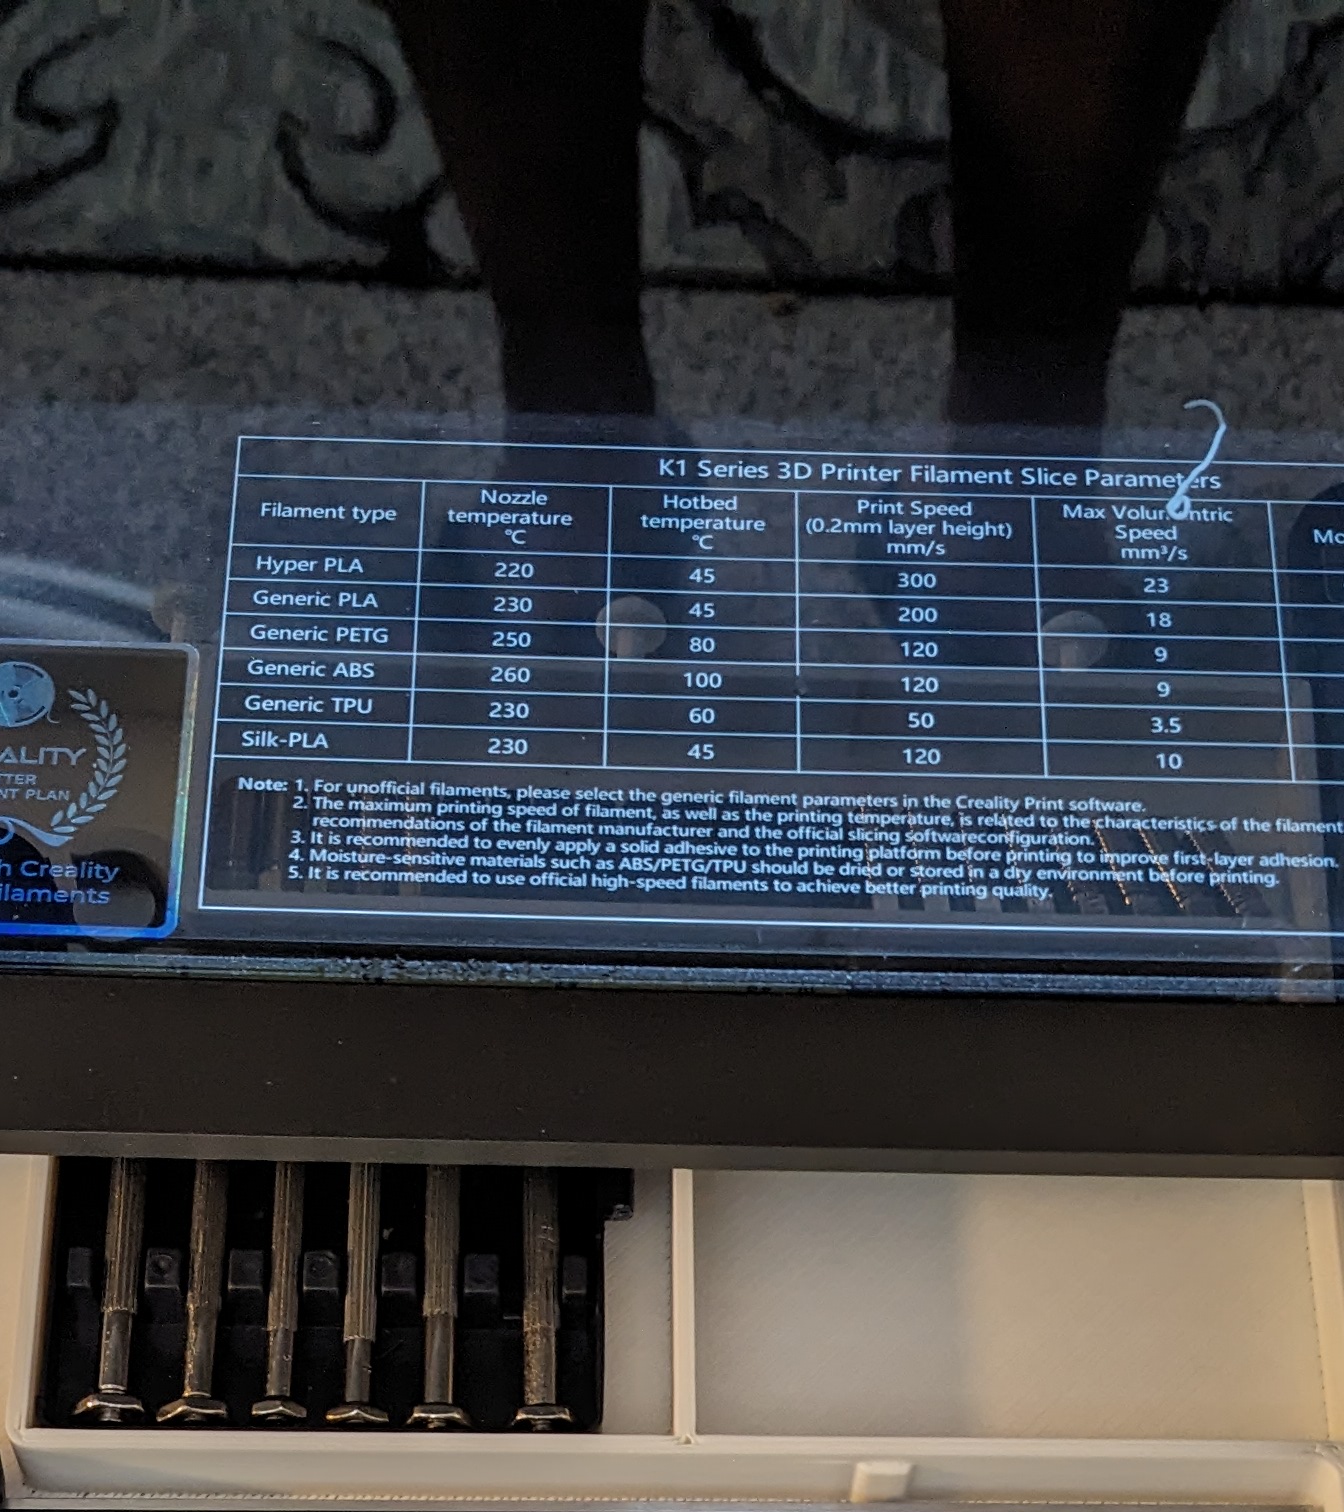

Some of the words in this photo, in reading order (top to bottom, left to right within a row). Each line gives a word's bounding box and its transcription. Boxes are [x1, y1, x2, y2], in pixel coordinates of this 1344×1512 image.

[659, 458, 686, 477] K1
[697, 459, 769, 479] Series
[777, 461, 813, 480] 3D
[821, 462, 903, 482] Printer
[910, 464, 1013, 485] Filament
[1021, 467, 1078, 486] Slice
[480, 489, 548, 506] Nozzle
[663, 494, 738, 511] Hotbed
[260, 501, 346, 520] Filament
[351, 506, 397, 524] type
[857, 499, 905, 515] Print
[910, 500, 973, 519] Speed
[1062, 503, 1106, 519] Max
[447, 509, 573, 528] temperature
[640, 514, 766, 533] temperature
[805, 517, 882, 535] (0.2mm
[888, 519, 936, 539] layer
[942, 520, 1013, 541] height)
[1115, 524, 1178, 543] Speed
[886, 540, 946, 557] mm/s
[256, 555, 318, 575] Hyper
[324, 557, 364, 573] PLA
[494, 562, 534, 578] 220
[688, 567, 716, 584] 45
[897, 572, 937, 589] 300
[1143, 577, 1169, 594] 23
[252, 589, 331, 607] Generic
[338, 592, 379, 608] PLA
[493, 596, 533, 613] 230
[688, 602, 715, 618] 45
[898, 606, 938, 623] 200
[1146, 612, 1172, 628] 18
[250, 624, 329, 642] Generic
[336, 626, 389, 644] PETG
[492, 631, 532, 648] 250
[689, 636, 715, 653] 80
[900, 641, 939, 658] 120
[1154, 646, 1168, 663] 9
[247, 659, 327, 677] Generic
[332, 662, 375, 679] ABS
[490, 666, 531, 683] 260
[683, 672, 723, 689] 100
[901, 676, 939, 693] 120
[1156, 681, 1171, 698] 9
[244, 694, 324, 713] Generic
[330, 697, 373, 714] TPU
[488, 701, 530, 719] 230
[688, 707, 716, 724] 60
[908, 712, 935, 729] 50
[1151, 716, 1182, 734] 3.5
[241, 730, 329, 749] Silk-PLA
[487, 737, 528, 755] 230
[687, 743, 715, 760] 45
[902, 748, 941, 765] 120
[1156, 753, 1183, 770] 10
[25, 788, 70, 801] PLAN
[238, 776, 289, 792] Note:
[295, 778, 309, 792] 1.
[313, 778, 343, 793] For
[346, 780, 425, 797] unofficial
[429, 781, 511, 799] filaments,
[516, 784, 572, 802] please
[575, 786, 624, 802] select
[628, 787, 657, 802] the
[660, 789, 724, 806] generic
[728, 790, 798, 806] filament
[802, 794, 899, 814] parameters
[902, 794, 919, 811] in
[922, 794, 952, 809] the
[955, 795, 1020, 817] Creality
[1024, 796, 1064, 811] Print
[1068, 797, 1146, 813] software.
[20, 860, 120, 883] Creality
